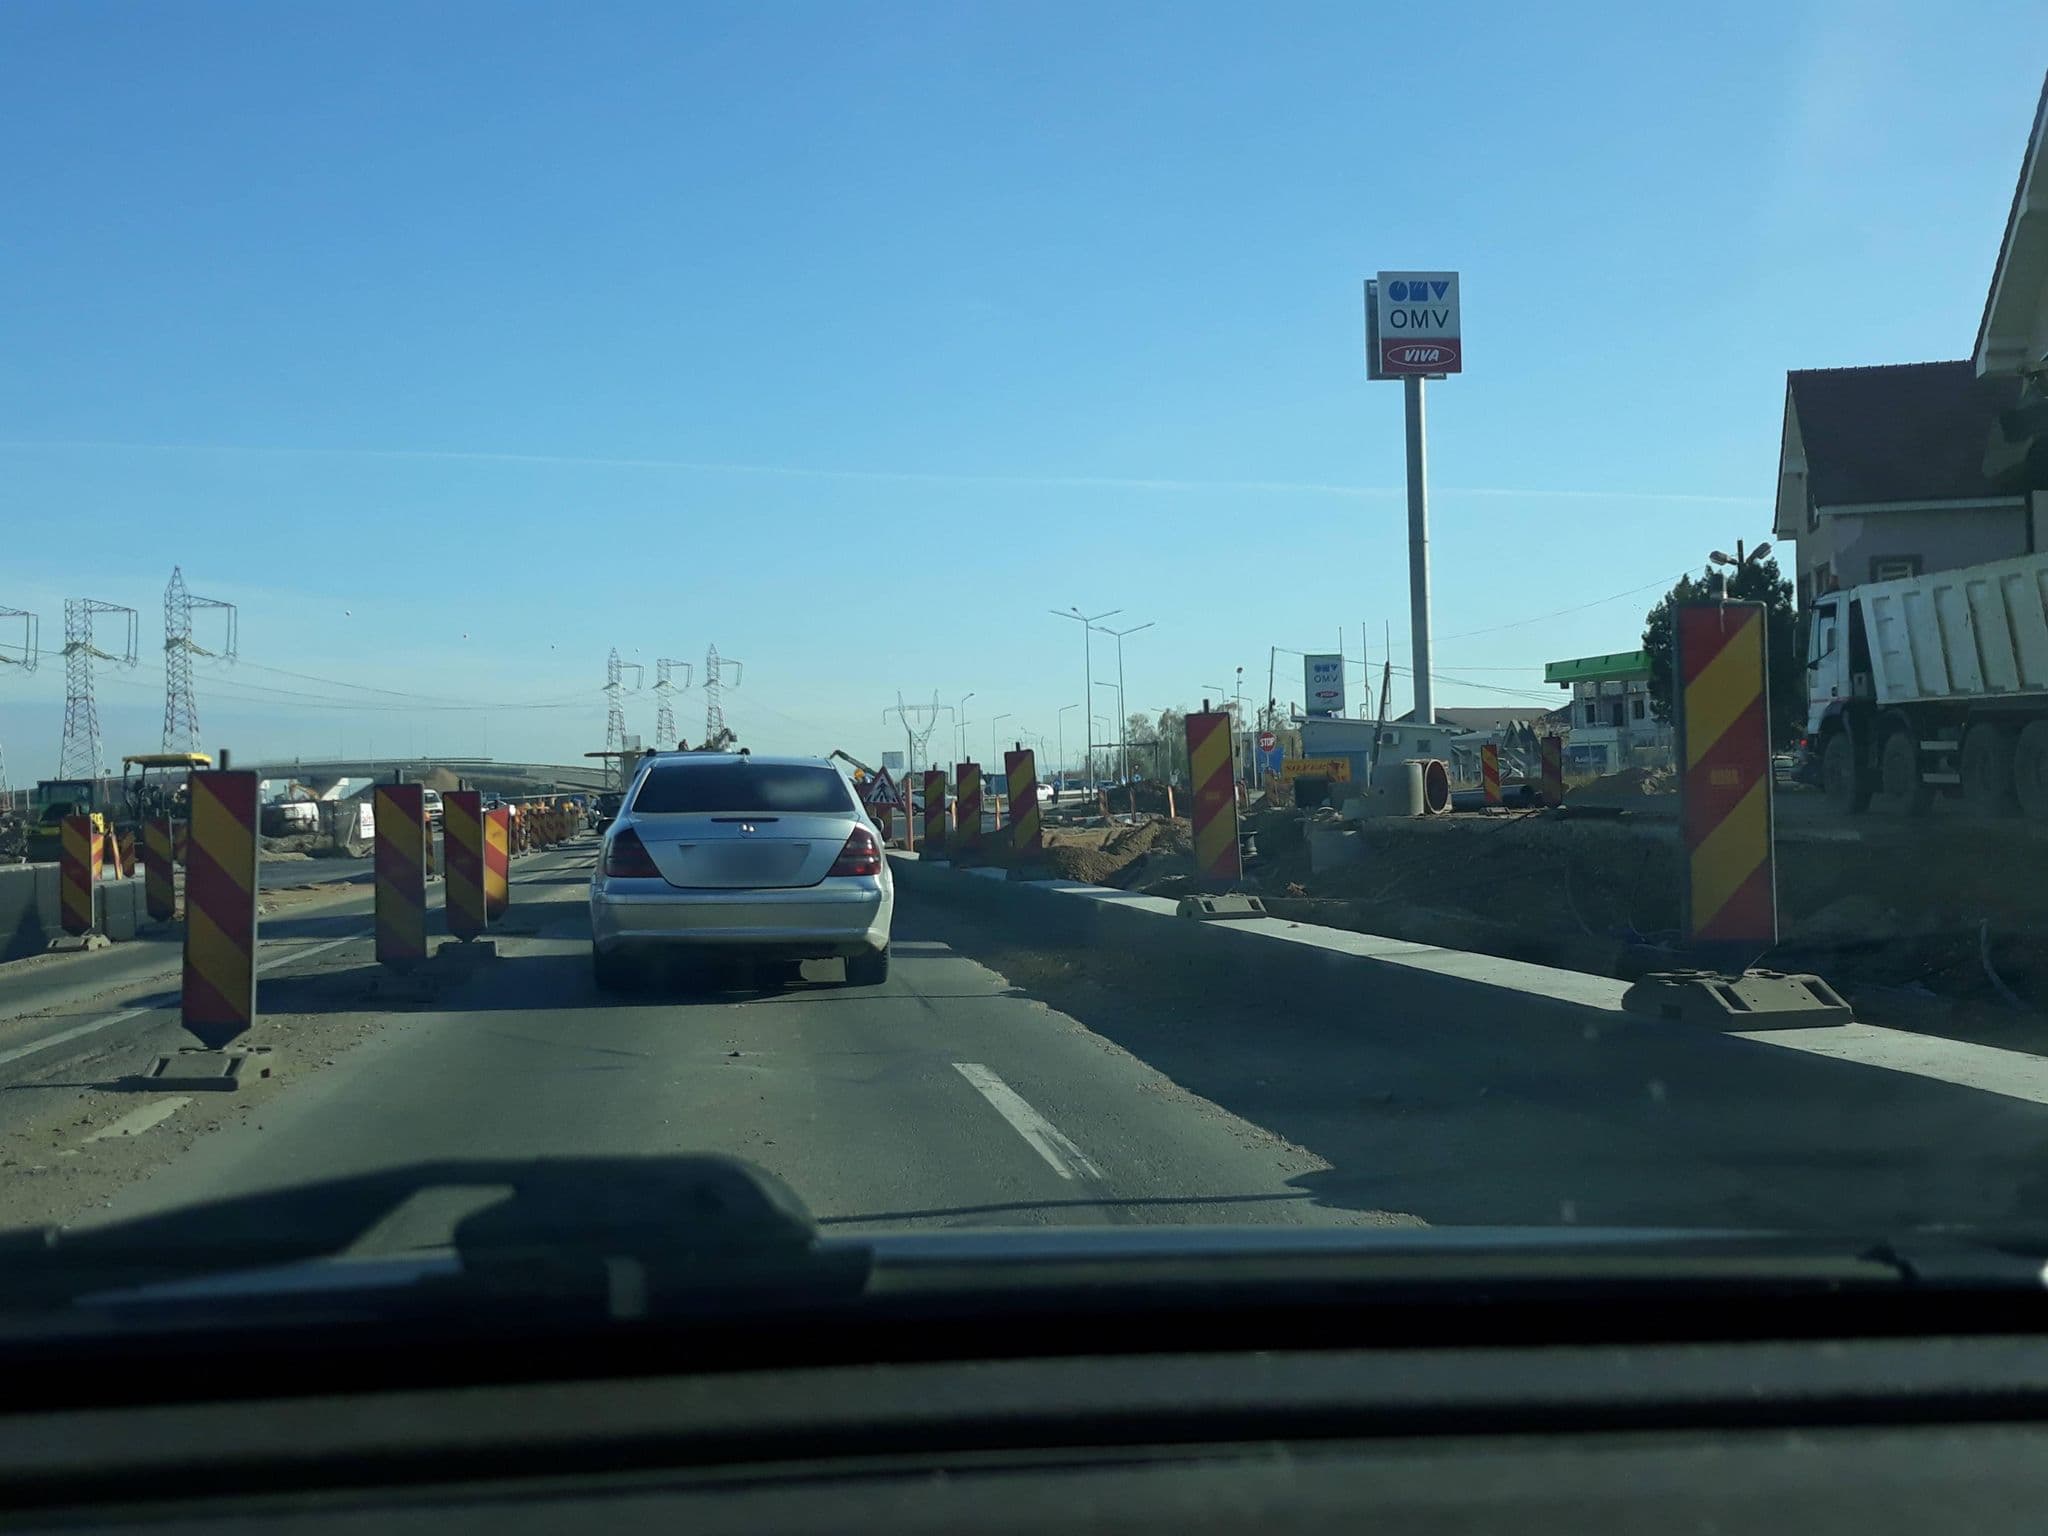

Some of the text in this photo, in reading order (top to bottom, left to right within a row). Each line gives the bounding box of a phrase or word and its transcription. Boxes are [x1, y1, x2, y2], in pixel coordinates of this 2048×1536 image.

[1390, 309, 1449, 328] OMV
[1405, 349, 1439, 361] VIVA
[1313, 674, 1338, 683] OMV
[1260, 738, 1275, 746] STOP
